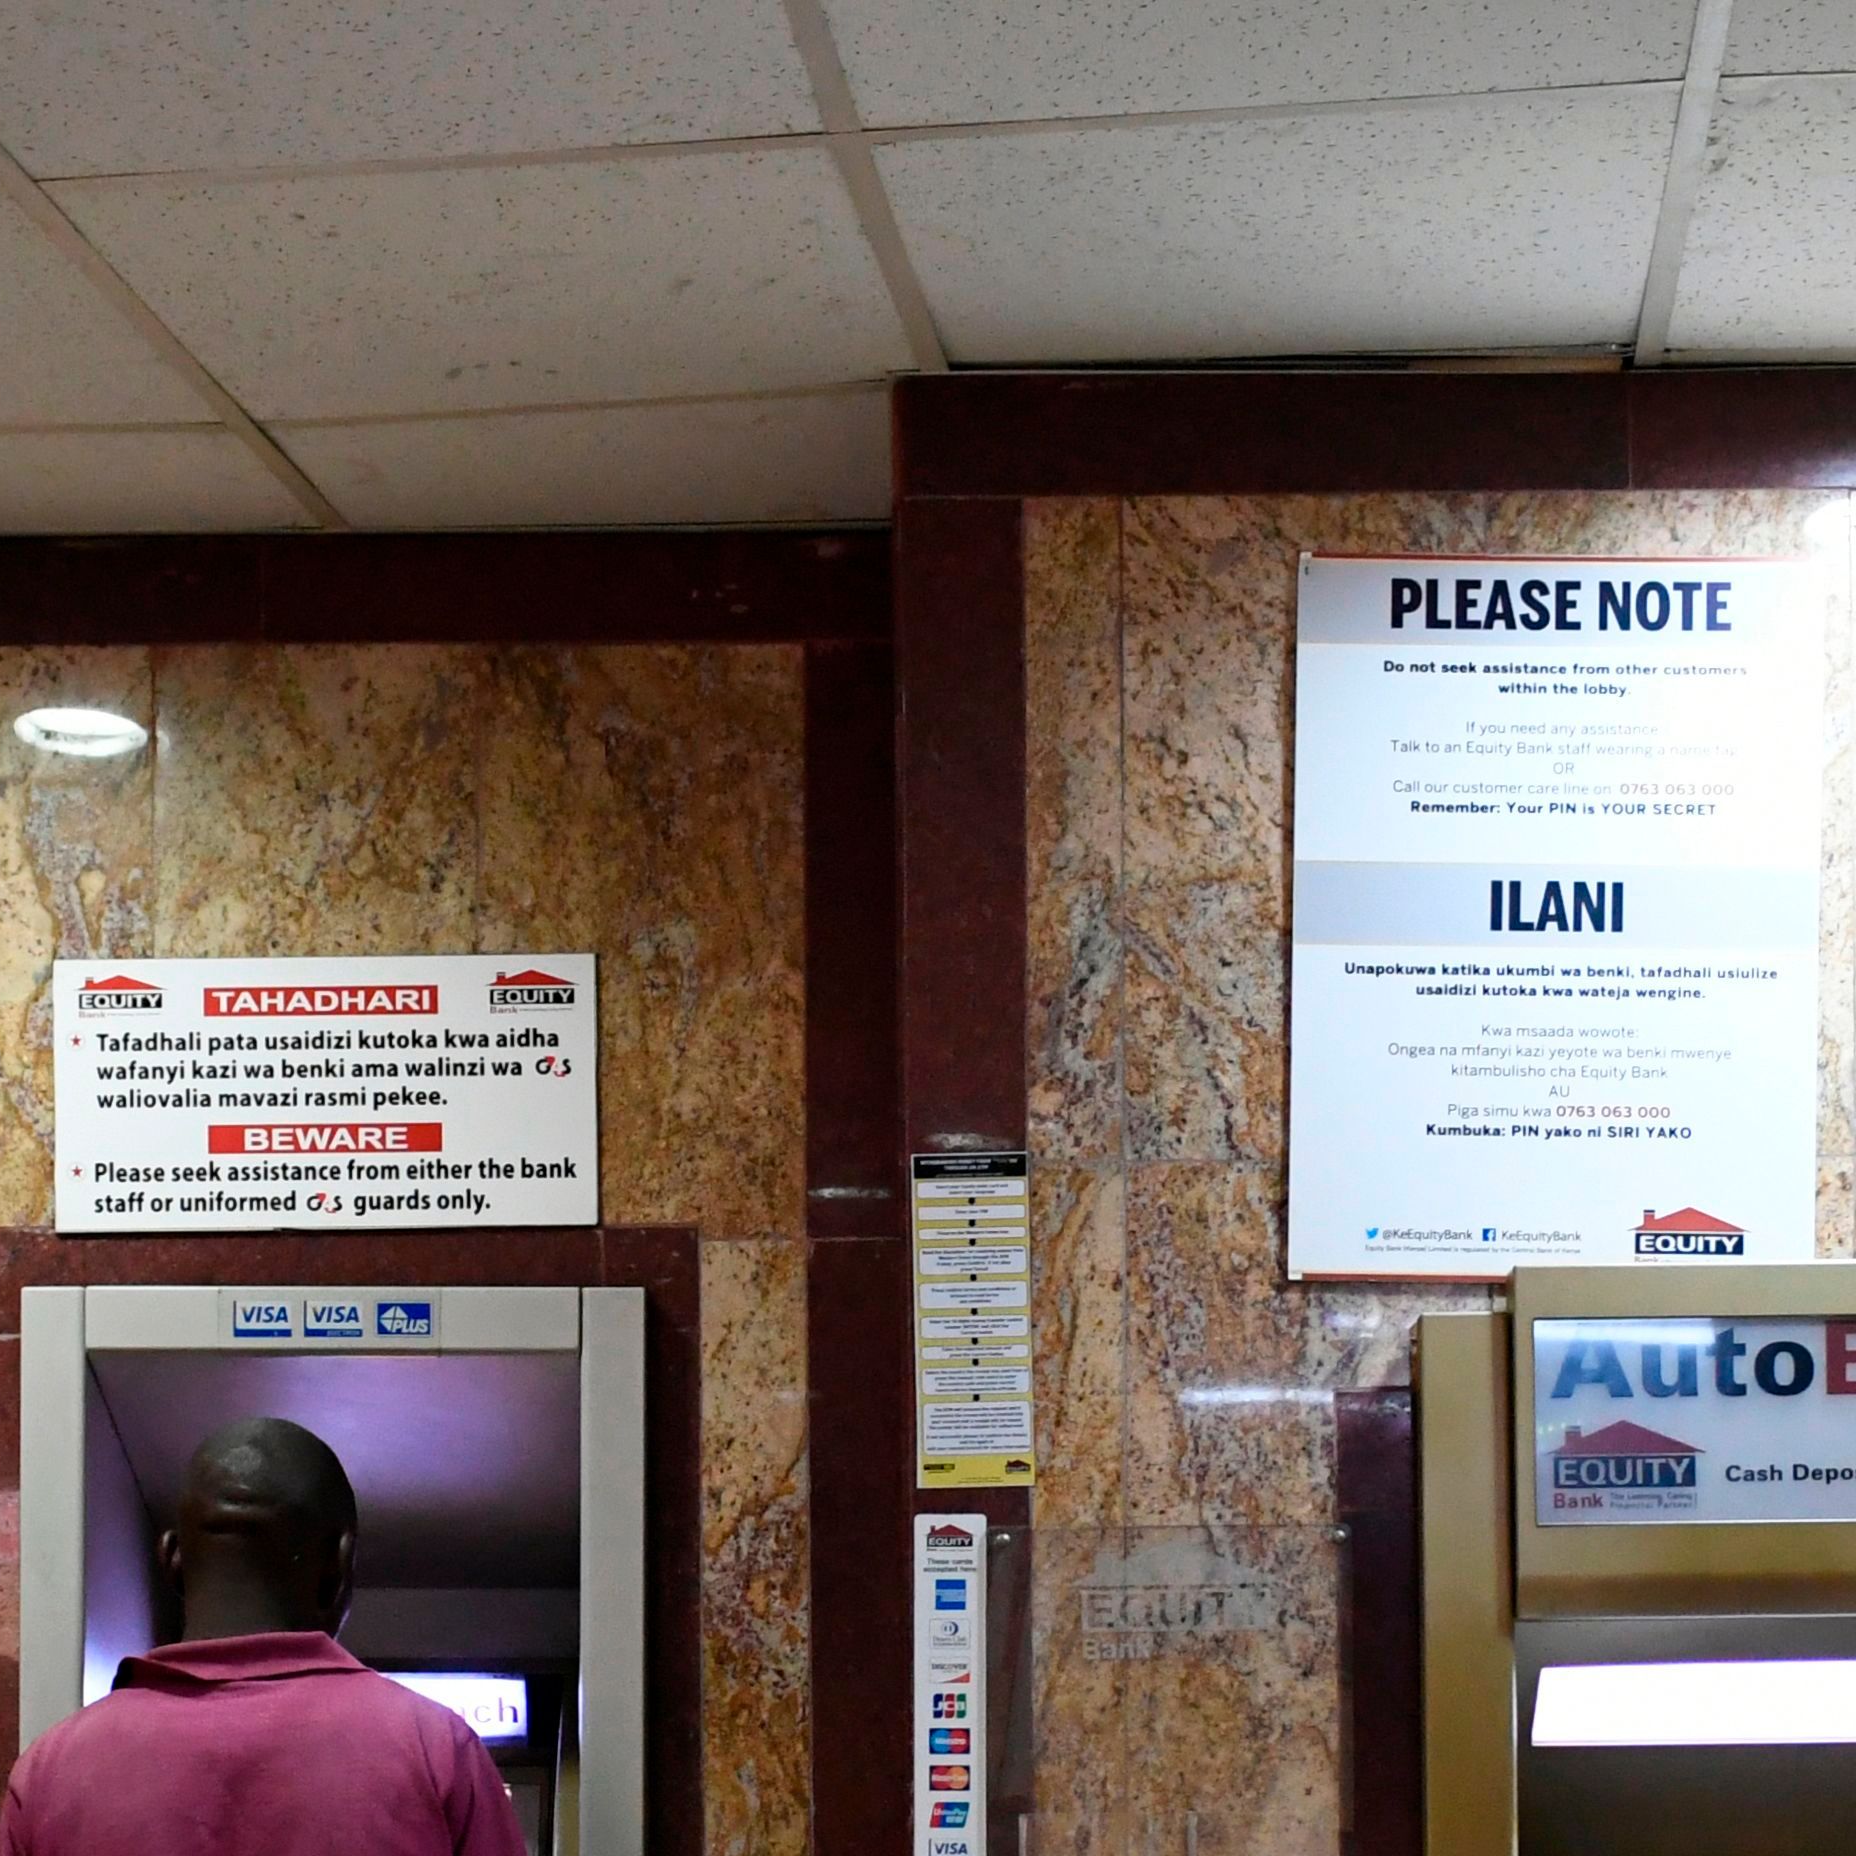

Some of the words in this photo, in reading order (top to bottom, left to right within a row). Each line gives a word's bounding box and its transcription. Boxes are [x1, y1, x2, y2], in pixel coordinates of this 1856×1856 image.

[1391, 578, 1581, 630] PLEASE
[1599, 581, 1731, 631] NOTE
[1384, 660, 1404, 672] Do
[1410, 662, 1435, 672] not
[1442, 662, 1476, 673] seek
[1483, 663, 1566, 674] assistance
[1573, 663, 1610, 674] from
[1616, 664, 1657, 674] other
[1664, 665, 1747, 675] customers
[1499, 683, 1547, 693] within
[1553, 683, 1578, 694] the
[1553, 762, 1574, 774] OR
[1411, 801, 1500, 813] Remember:
[1507, 802, 1543, 813] Your
[1550, 803, 1576, 813] PIN
[1583, 804, 1595, 814] is
[1602, 804, 1646, 815] YOUR
[1653, 804, 1715, 815] SECRET
[1490, 880, 1623, 932] ILANI
[1345, 963, 1436, 977] Unapokuwa
[1442, 964, 1490, 975] katika
[1497, 965, 1554, 976] ukumbi
[1587, 966, 1634, 978] benki,
[1641, 967, 1711, 978] tafadhali
[1718, 968, 1777, 979] usiulize
[493, 990, 573, 1005] EQUITY
[1416, 984, 1476, 995] usaidizi
[1483, 985, 1536, 996] kutoka
[1543, 986, 1573, 996] kwa
[1579, 987, 1629, 1000] wateja
[1636, 987, 1705, 1000] wengine.
[82, 994, 161, 1008] EQUITY
[212, 990, 430, 1012] TAHADHARI
[96, 1032, 200, 1051] Tafadhali
[209, 1034, 257, 1055] pata
[265, 1030, 351, 1050] usaidizi
[359, 1029, 437, 1049] kutoka
[445, 1029, 489, 1048] kwa
[496, 1028, 558, 1047] aidha
[1388, 1043, 1435, 1058] Ongea
[1440, 1047, 1457, 1056] na
[1462, 1044, 1511, 1059] mfanyi
[1516, 1045, 1544, 1057] kazi
[1549, 1047, 1597, 1060] yeyote
[1602, 1049, 1622, 1058] wa
[1627, 1046, 1666, 1058] benki
[1671, 1050, 1731, 1062] mwenye
[97, 1060, 184, 1084] wafanyi
[192, 1060, 236, 1079] kazi
[244, 1065, 274, 1078] wa
[282, 1058, 344, 1078] benki
[352, 1063, 398, 1077] ama
[405, 1057, 484, 1076] walinzi
[492, 1062, 522, 1075] wa
[1452, 1064, 1545, 1077] kitambulisho
[1550, 1066, 1576, 1077] cha
[1581, 1065, 1627, 1080] Equity
[1632, 1066, 1667, 1078] Bank
[97, 1088, 211, 1108] waliovalia
[219, 1087, 297, 1107] mavazi
[305, 1087, 366, 1106] rasmi
[374, 1086, 447, 1110] pekee.
[1549, 1085, 1569, 1097] AU
[1448, 1104, 1478, 1119] Piga
[1484, 1105, 1518, 1117] simu
[1523, 1106, 1551, 1117] kwa
[1556, 1106, 1595, 1117] 0763
[1601, 1106, 1632, 1118] 063
[1638, 1107, 1670, 1118] 000
[244, 1127, 408, 1151] BEWARE
[1427, 1124, 1505, 1136] Kumbuka:
[1512, 1125, 1538, 1136] PIN
[1545, 1126, 1582, 1140] yako
[1588, 1126, 1601, 1137] ni
[1608, 1126, 1639, 1138] SIRI
[1646, 1127, 1691, 1139] YAKO
[95, 1162, 165, 1182] Please
[172, 1161, 221, 1182] seek
[228, 1161, 341, 1181] assistance
[347, 1159, 399, 1180] from
[407, 1159, 472, 1179] either
[478, 1158, 514, 1179] the
[521, 1157, 576, 1178] bank
[95, 1192, 144, 1213] staff
[151, 1198, 173, 1212] or
[180, 1190, 296, 1212] uniformed
[354, 1189, 430, 1216] guards
[437, 1189, 490, 1215] only.
[1383, 1229, 1472, 1242] @KeEquityBank
[1502, 1230, 1581, 1243] KeEquityBank
[1639, 1234, 1738, 1255] EQUITY
[242, 1306, 288, 1323] VISA
[313, 1306, 360, 1323] VISA
[393, 1319, 429, 1333] PLUS
[1557, 1458, 1692, 1488] EQUITY
[1726, 1465, 1783, 1482] Cash
[1554, 1493, 1603, 1509] Bank
[935, 1842, 968, 1855] VISA
